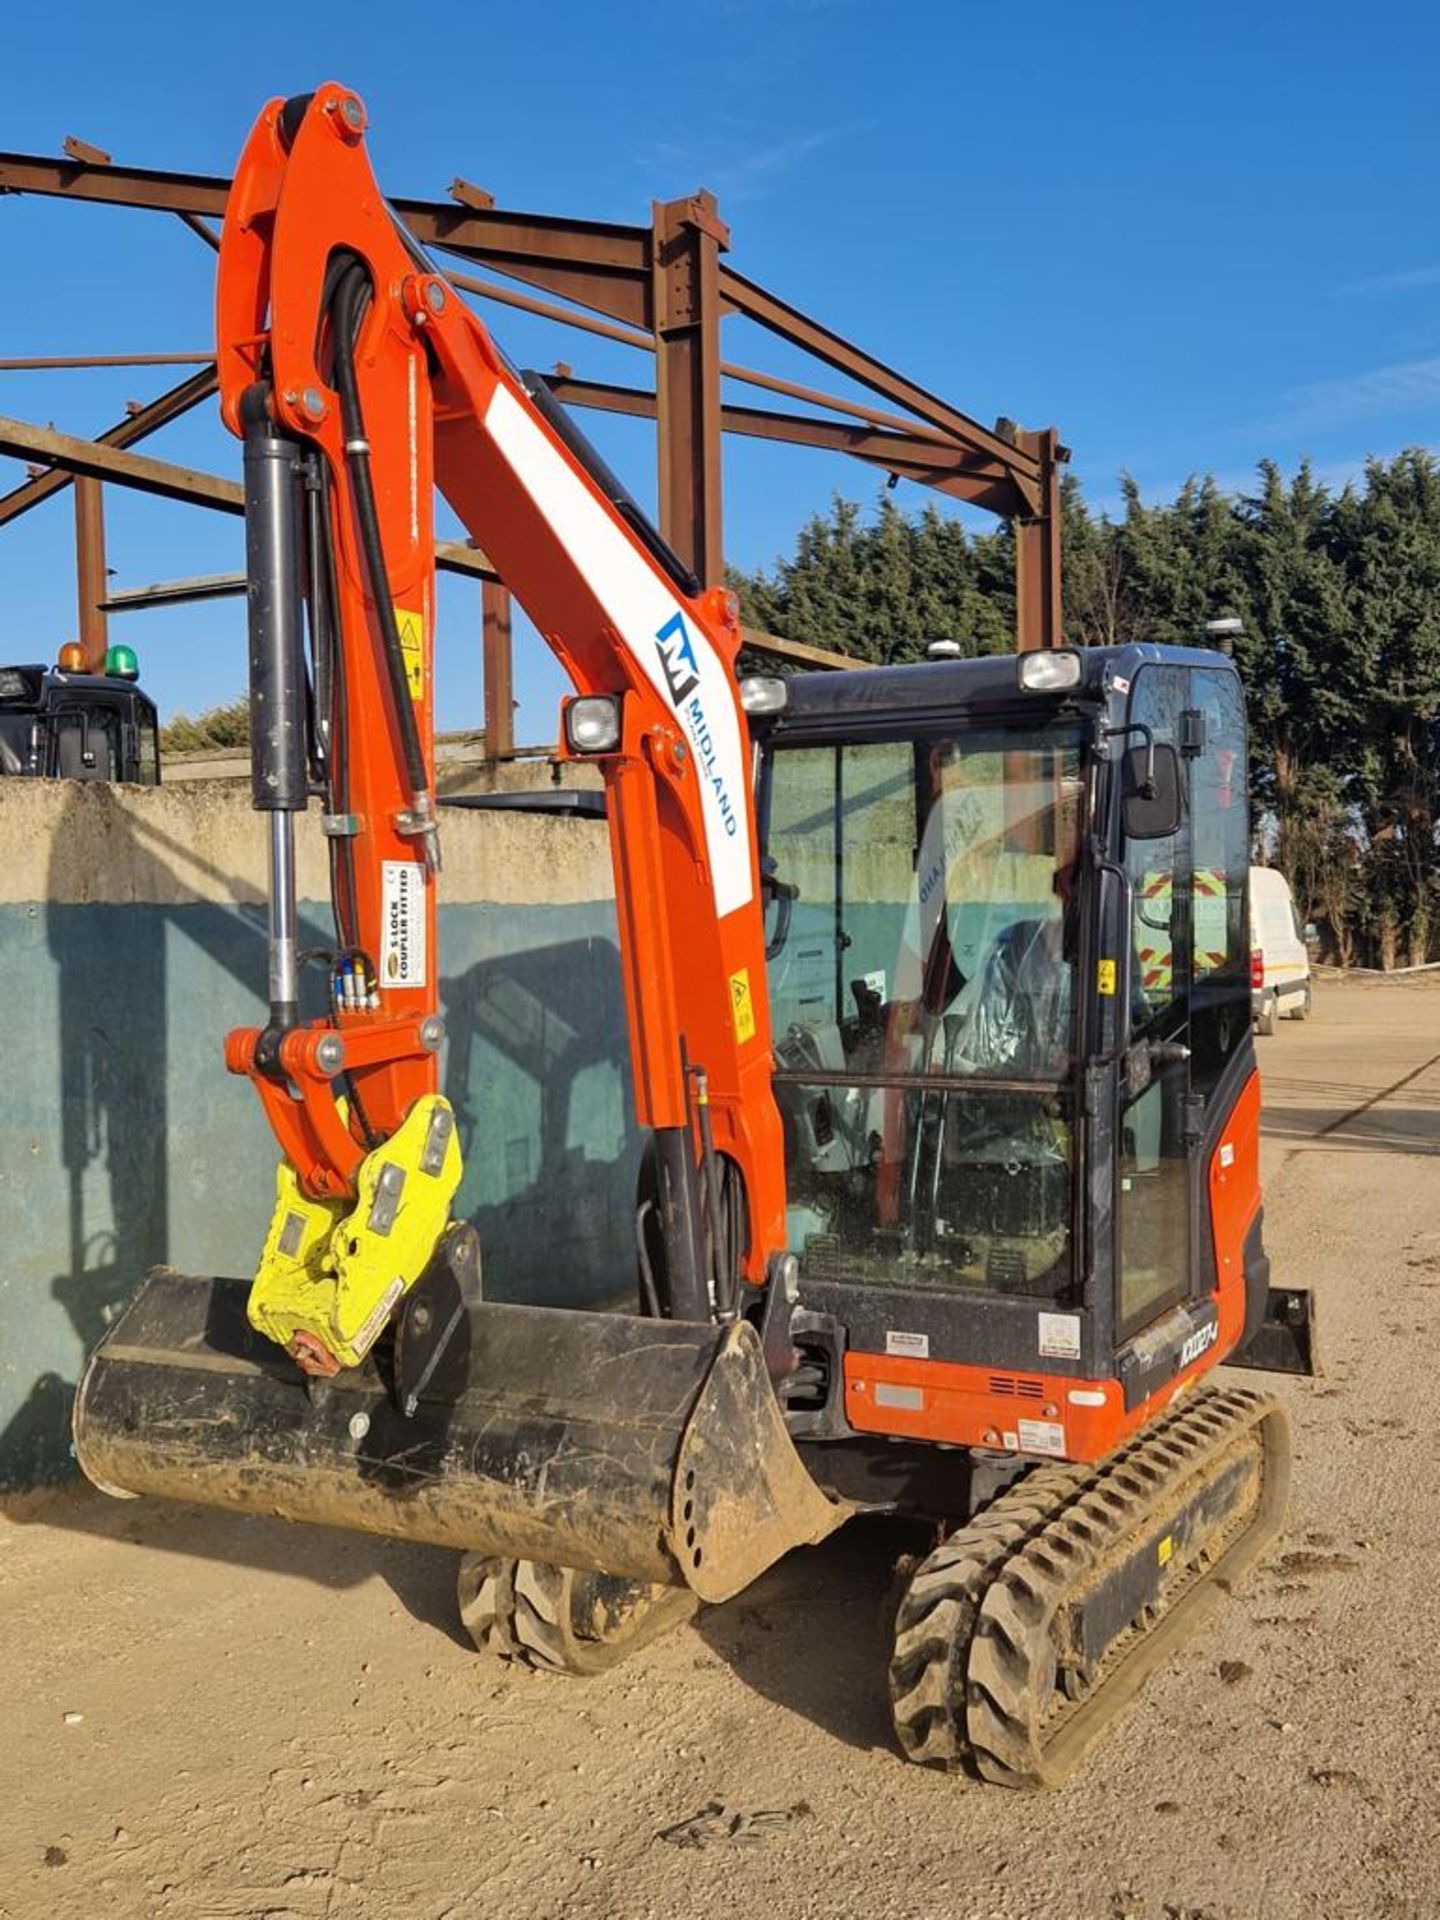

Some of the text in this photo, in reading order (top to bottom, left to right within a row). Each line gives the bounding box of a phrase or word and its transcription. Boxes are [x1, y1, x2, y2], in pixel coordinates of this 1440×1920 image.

[689, 697, 736, 837] MIDLAND
[399, 869, 408, 979] COUPLER FITTED
